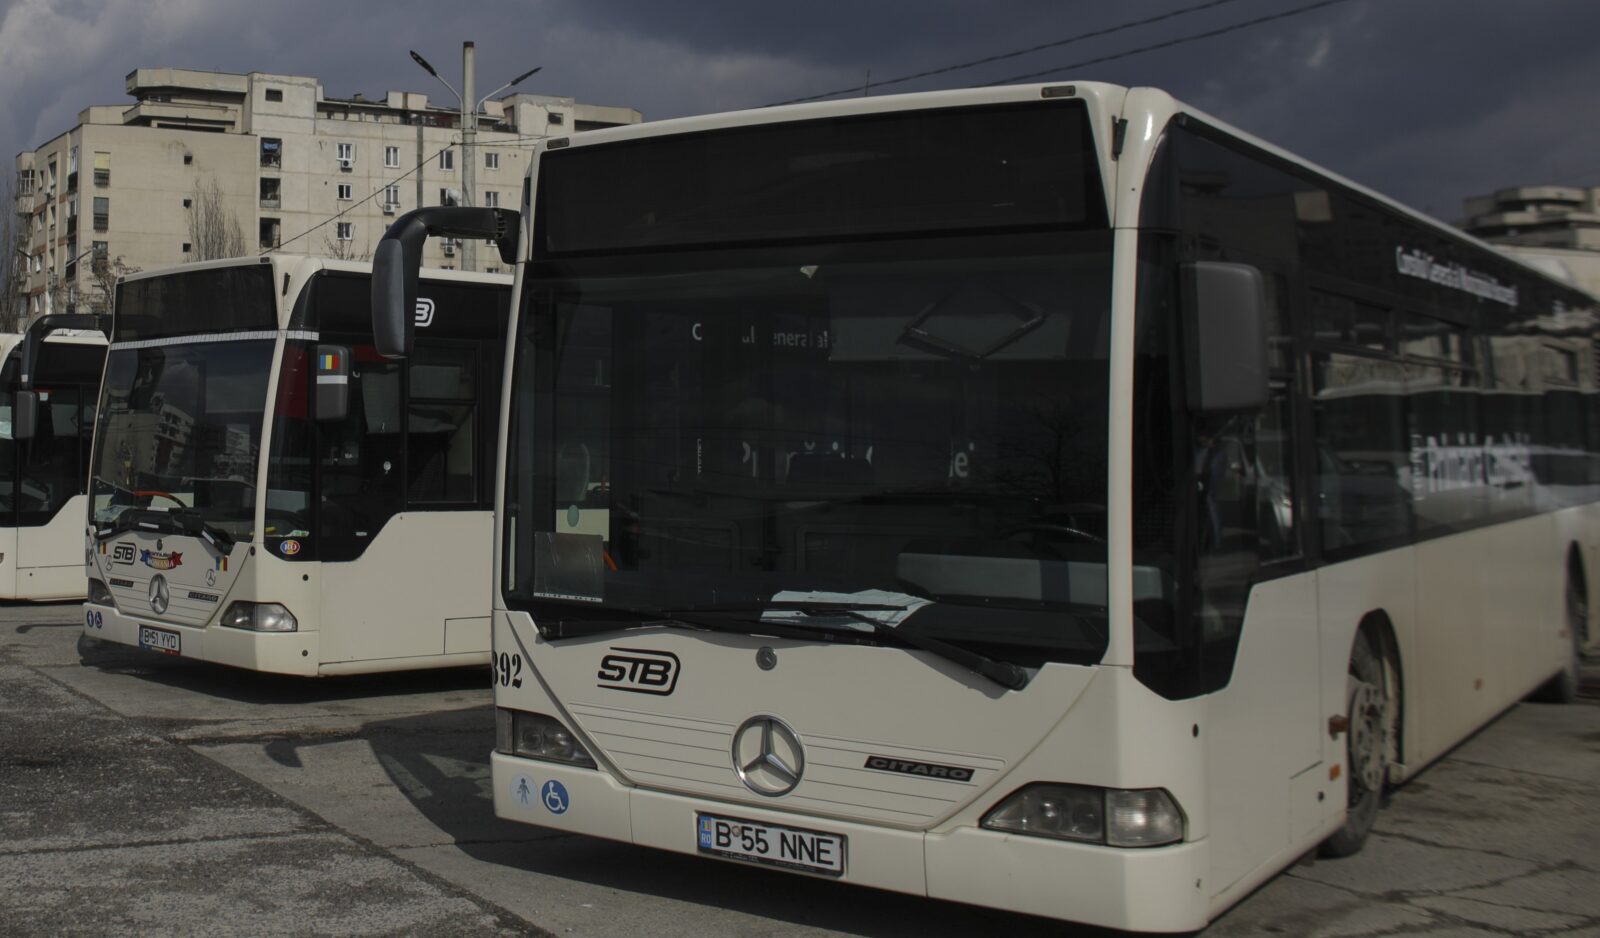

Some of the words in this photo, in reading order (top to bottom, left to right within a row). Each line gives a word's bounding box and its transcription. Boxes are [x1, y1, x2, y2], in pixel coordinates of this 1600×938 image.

[113, 546, 134, 561] STB
[160, 633, 177, 649] YYD
[597, 654, 672, 686] STB
[869, 758, 970, 780] CITARO
[701, 832, 712, 845] RO
[715, 821, 732, 848] B
[740, 826, 769, 854] 55
[780, 832, 834, 866] NNE
